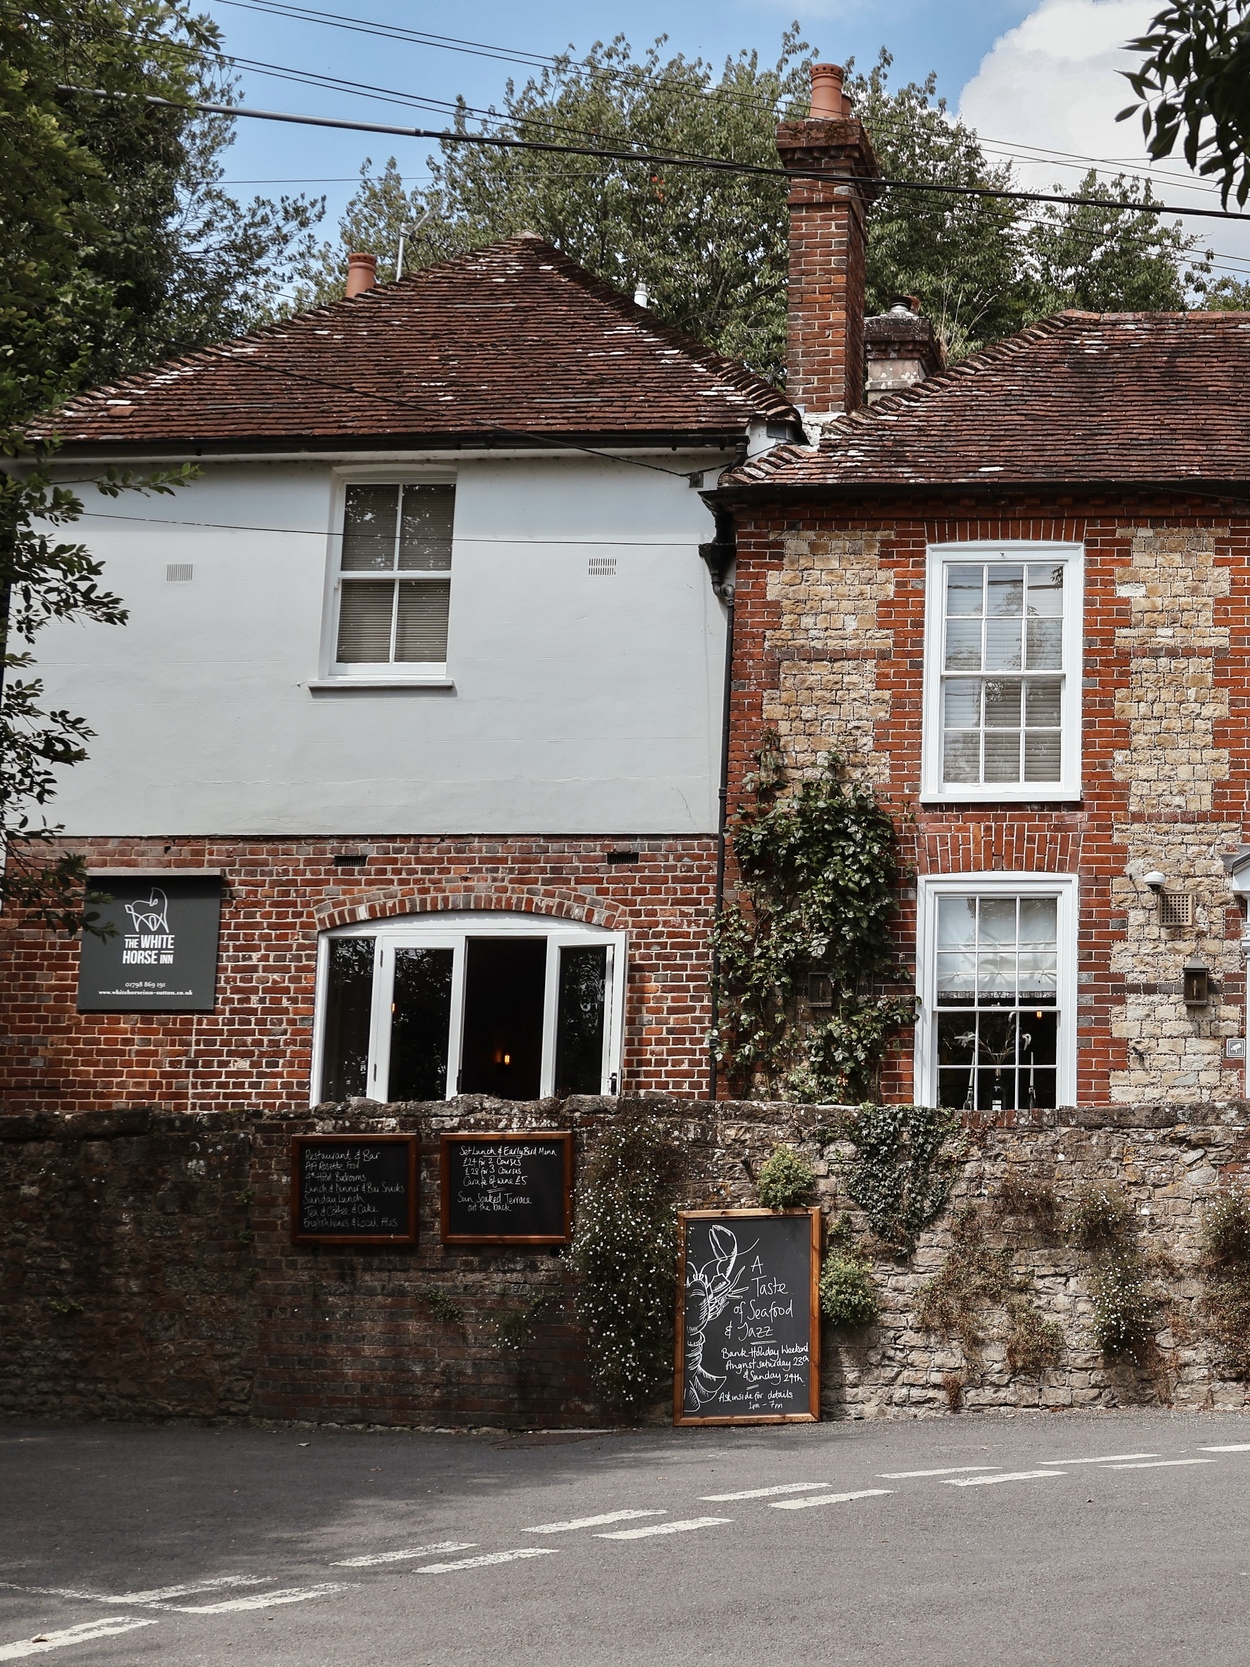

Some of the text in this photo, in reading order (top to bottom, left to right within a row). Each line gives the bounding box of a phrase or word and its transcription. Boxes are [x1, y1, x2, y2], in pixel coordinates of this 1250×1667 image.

[125, 935, 175, 948] THE WHITE
[122, 951, 173, 964] HORSE INN
[305, 1149, 380, 1161] Restaurant & Bar
[460, 1146, 472, 1155] Set
[472, 1146, 497, 1156] Lunch
[504, 1146, 523, 1159] Early
[523, 1147, 537, 1155] Bird
[539, 1147, 557, 1156] Menu
[305, 1161, 317, 1170] AA
[319, 1161, 345, 1170] Rosette
[463, 1157, 477, 1167] £24
[497, 1158, 521, 1166] Courses
[489, 1165, 495, 1173] 3
[335, 1172, 366, 1181] Bedrooms
[463, 1176, 487, 1188] Carafe
[515, 1175, 528, 1185] £5
[305, 1183, 328, 1193] Lunch
[335, 1183, 360, 1193] Dinner
[382, 1181, 405, 1193] Snacks
[303, 1193, 365, 1204] Sunday Lunch
[457, 1191, 532, 1204] Sun Soaked Terrace
[304, 1205, 318, 1218] Tea
[327, 1205, 351, 1217] Coffee
[358, 1204, 379, 1215] Cake
[357, 1218, 378, 1227] Local
[381, 1217, 397, 1226] Ales
[751, 1255, 763, 1274] A
[751, 1275, 788, 1297] Taste
[733, 1299, 793, 1323] of Seafood
[725, 1320, 773, 1341] & Jazz
[721, 1342, 809, 1361] Bank Holiday Weekend
[725, 1358, 756, 1374] August
[743, 1369, 748, 1379] &
[748, 1370, 781, 1385] Sunday
[719, 1389, 793, 1402] Ask inside for details
